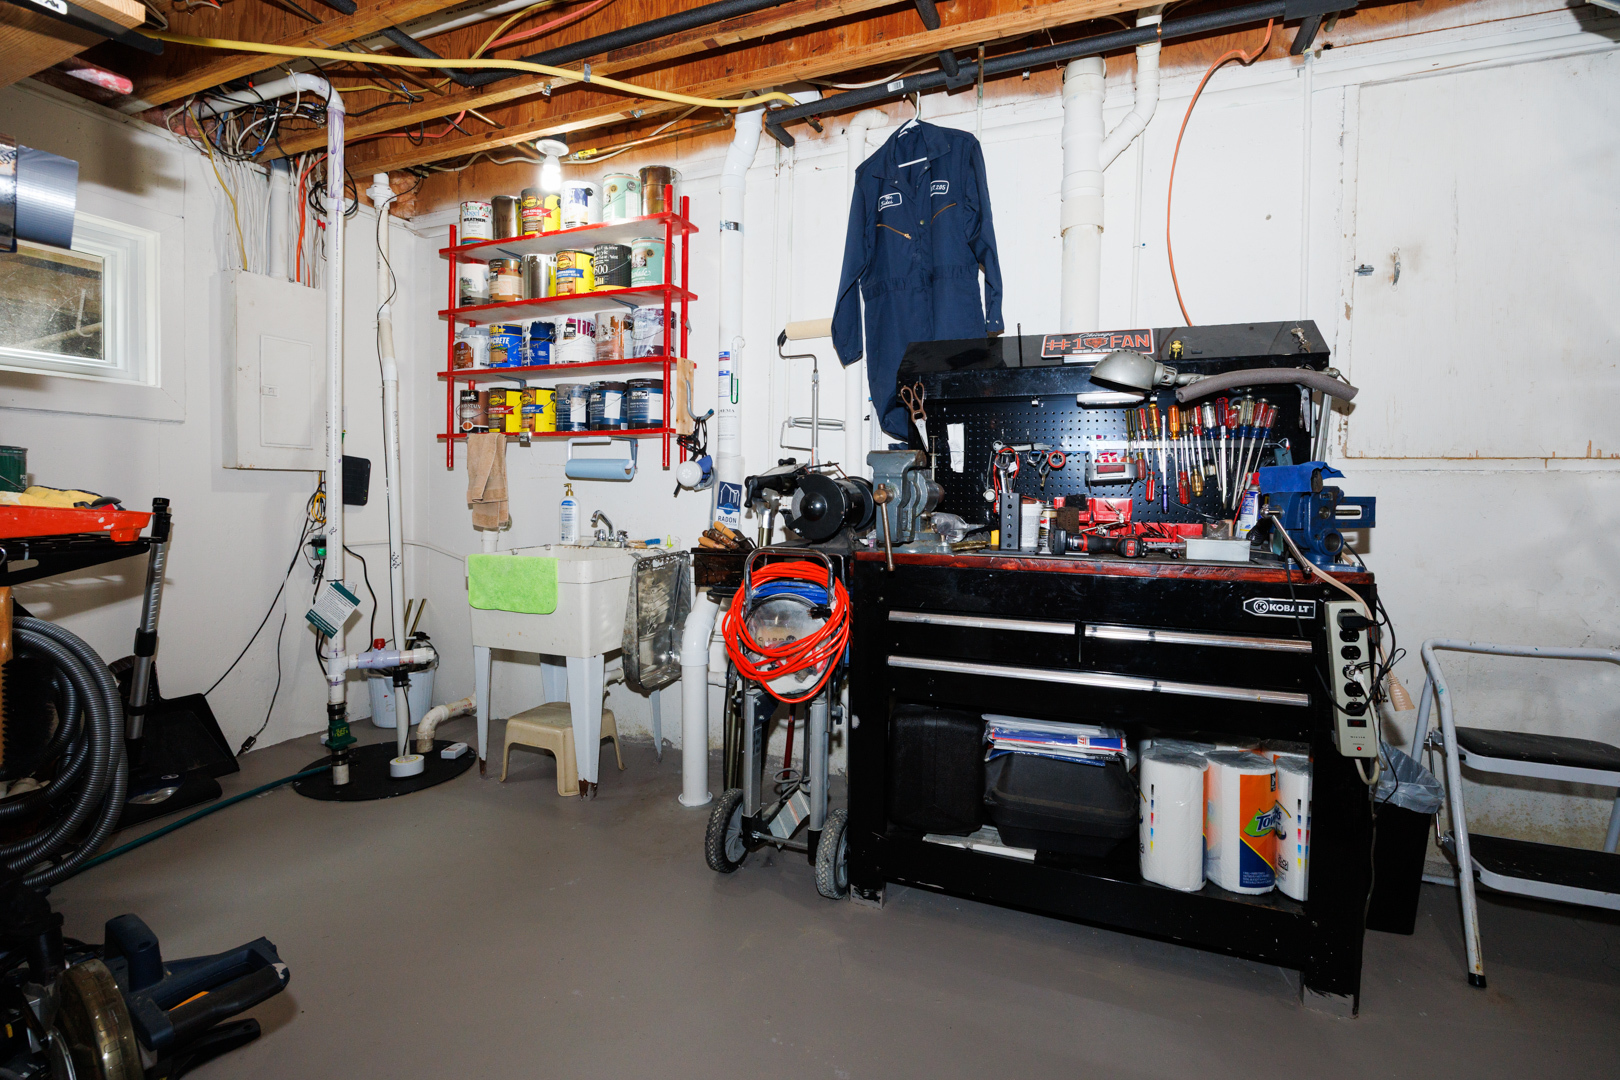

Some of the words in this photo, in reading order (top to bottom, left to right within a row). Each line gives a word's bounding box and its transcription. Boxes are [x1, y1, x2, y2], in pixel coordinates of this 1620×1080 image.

[1046, 338, 1085, 350] #1
[1109, 334, 1150, 349] FAN
[718, 515, 737, 523] RADON
[1269, 603, 1310, 613] KOBALT
